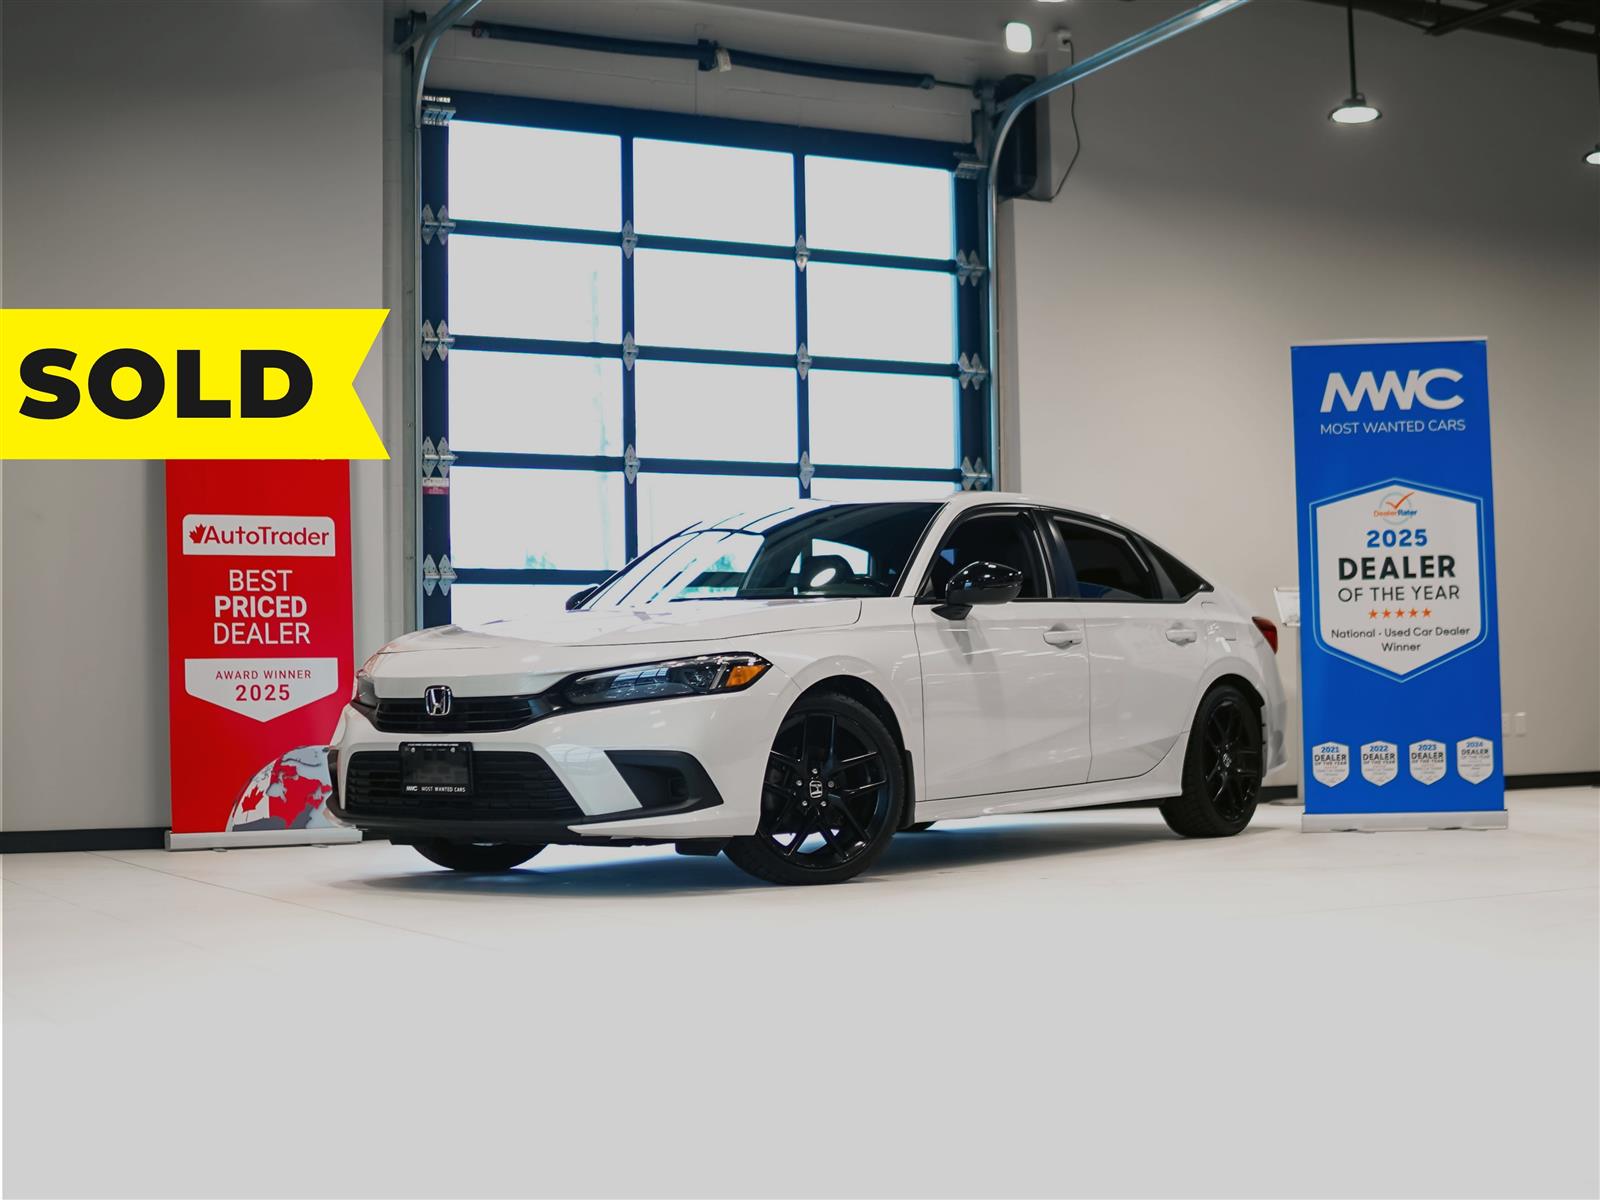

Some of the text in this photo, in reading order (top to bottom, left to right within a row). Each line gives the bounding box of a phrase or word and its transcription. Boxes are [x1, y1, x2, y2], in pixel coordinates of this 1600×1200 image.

[1320, 368, 1464, 413] MWC
[1320, 419, 1466, 435] MOST WANTED CARS
[204, 525, 330, 545] AutoTrader
[1366, 529, 1428, 548] 2025
[1338, 555, 1456, 581] DEALER
[229, 569, 293, 592] BEST
[1338, 585, 1460, 602] OF THE YEAR
[214, 595, 307, 618] PRICED
[213, 622, 311, 645] DEALER
[1331, 628, 1376, 638] National
[1384, 627, 1411, 638] Used
[1413, 627, 1434, 637] Car
[1435, 626, 1470, 636] Dealer
[1381, 642, 1421, 652] Winner
[215, 669, 312, 680] AWARD WINNER
[235, 684, 290, 701] 2025
[1362, 753, 1396, 761] DEALER
[1411, 752, 1444, 760] DEALER
